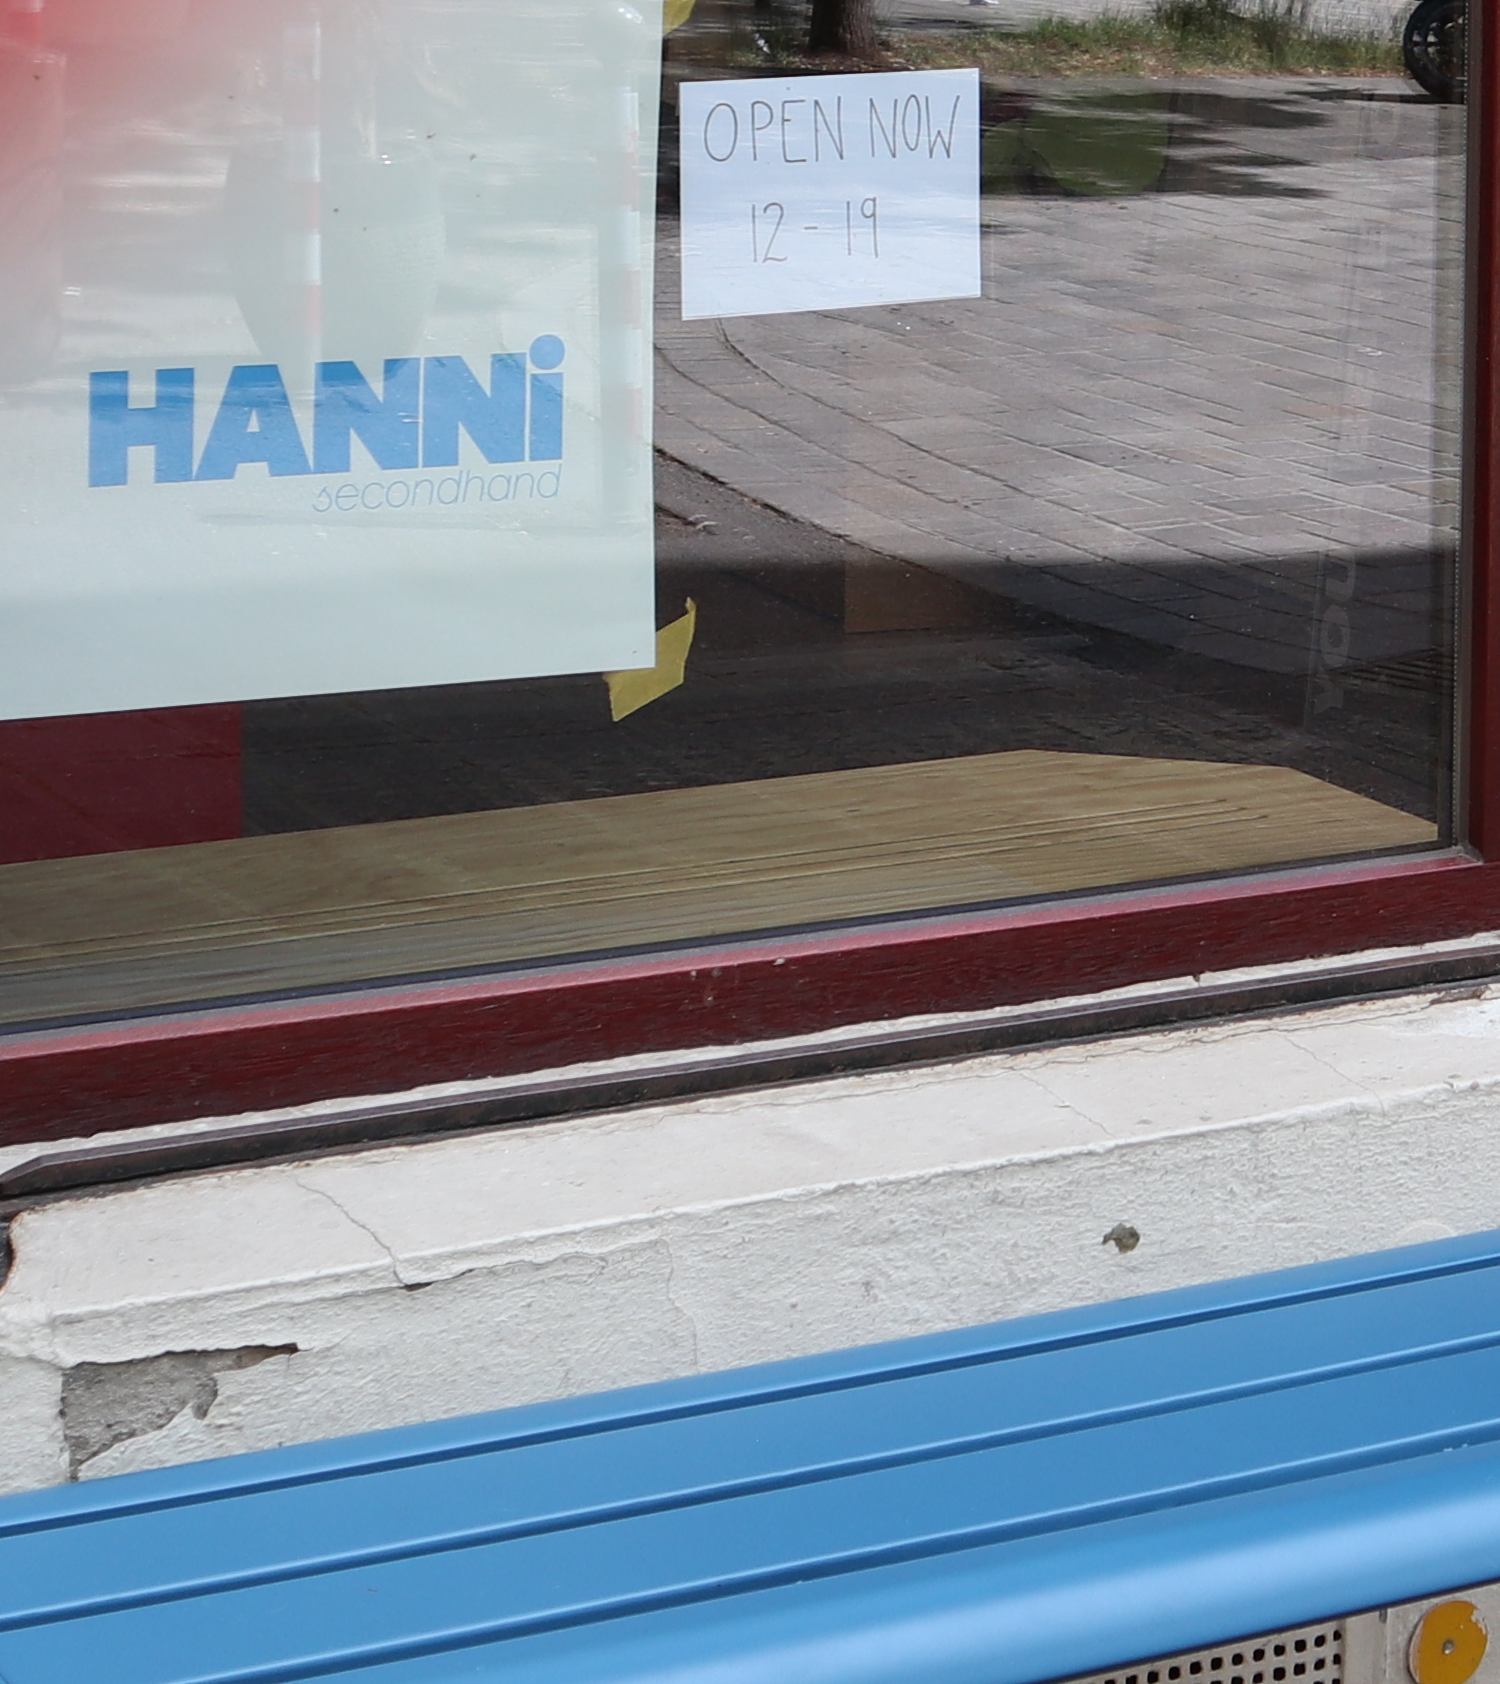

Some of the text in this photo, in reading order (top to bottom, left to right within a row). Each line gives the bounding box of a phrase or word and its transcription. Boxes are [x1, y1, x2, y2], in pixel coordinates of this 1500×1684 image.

[703, 93, 961, 163] OPEN NOW
[752, 202, 788, 263] 12
[846, 197, 879, 259] 19
[311, 465, 563, 514] secondhand
